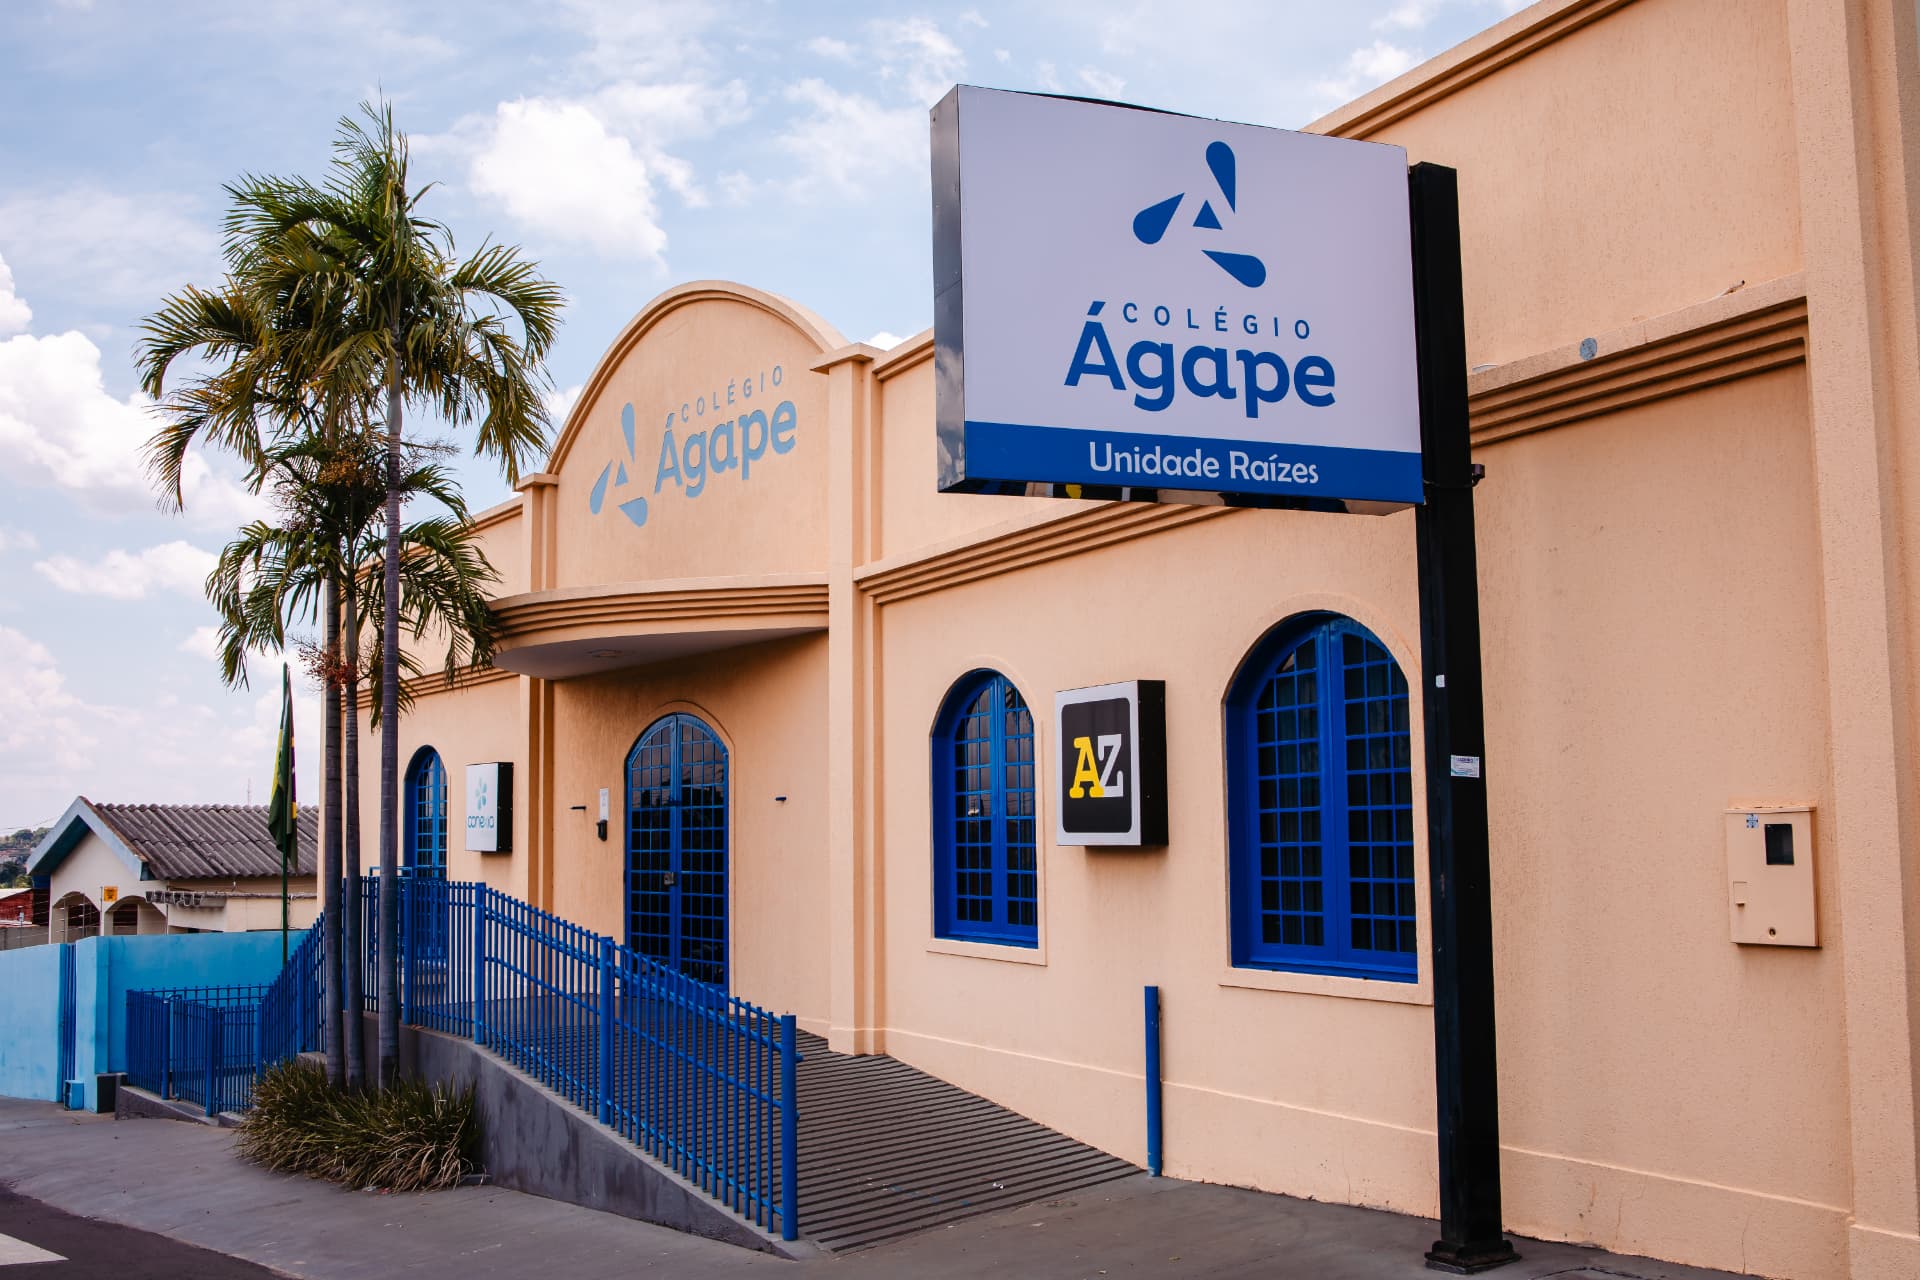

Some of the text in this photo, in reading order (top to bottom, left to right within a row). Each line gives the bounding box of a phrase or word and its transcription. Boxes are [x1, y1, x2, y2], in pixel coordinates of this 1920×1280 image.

[1122, 302, 1310, 339] COLÉGIO
[1064, 301, 1336, 419] Ágape
[681, 366, 782, 422] COLÉGIO
[654, 401, 797, 498] Ágape
[1089, 442, 1319, 484] Unidade Raízes
[1069, 734, 1124, 798] AZ
